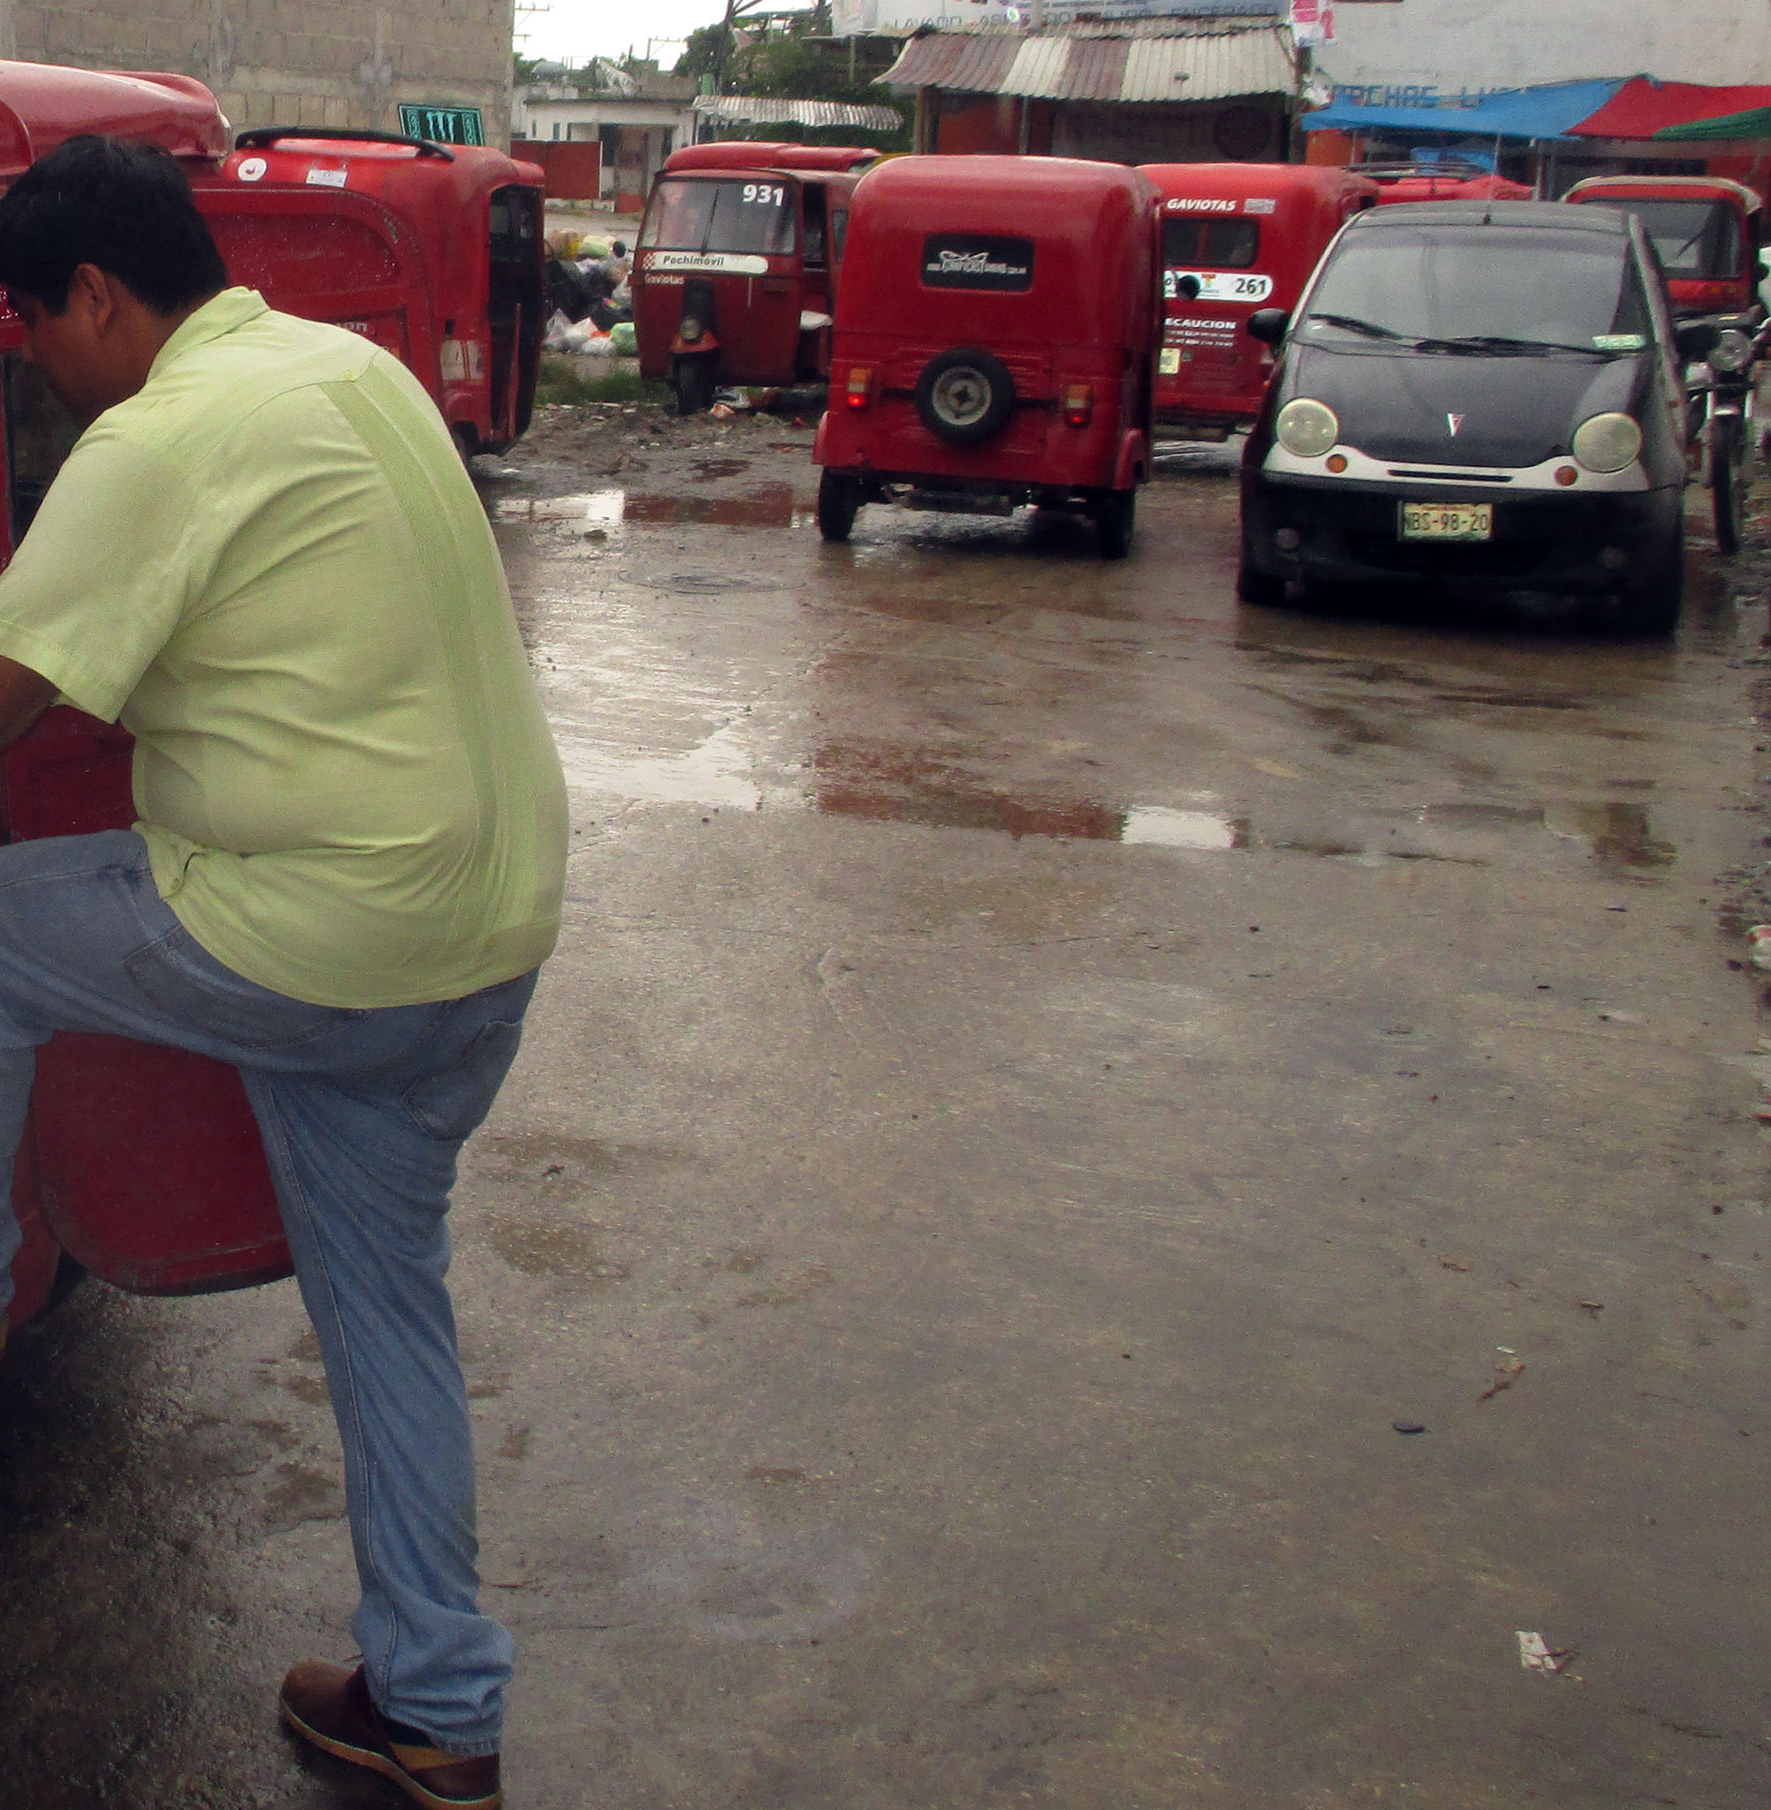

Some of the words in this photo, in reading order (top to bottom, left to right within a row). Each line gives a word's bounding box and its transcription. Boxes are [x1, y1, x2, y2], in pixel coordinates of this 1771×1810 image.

[742, 184, 785, 206] 931
[1166, 198, 1237, 212] GAVIOTAS
[1235, 277, 1267, 295] 261
[1163, 317, 1237, 330] ECAUCION
